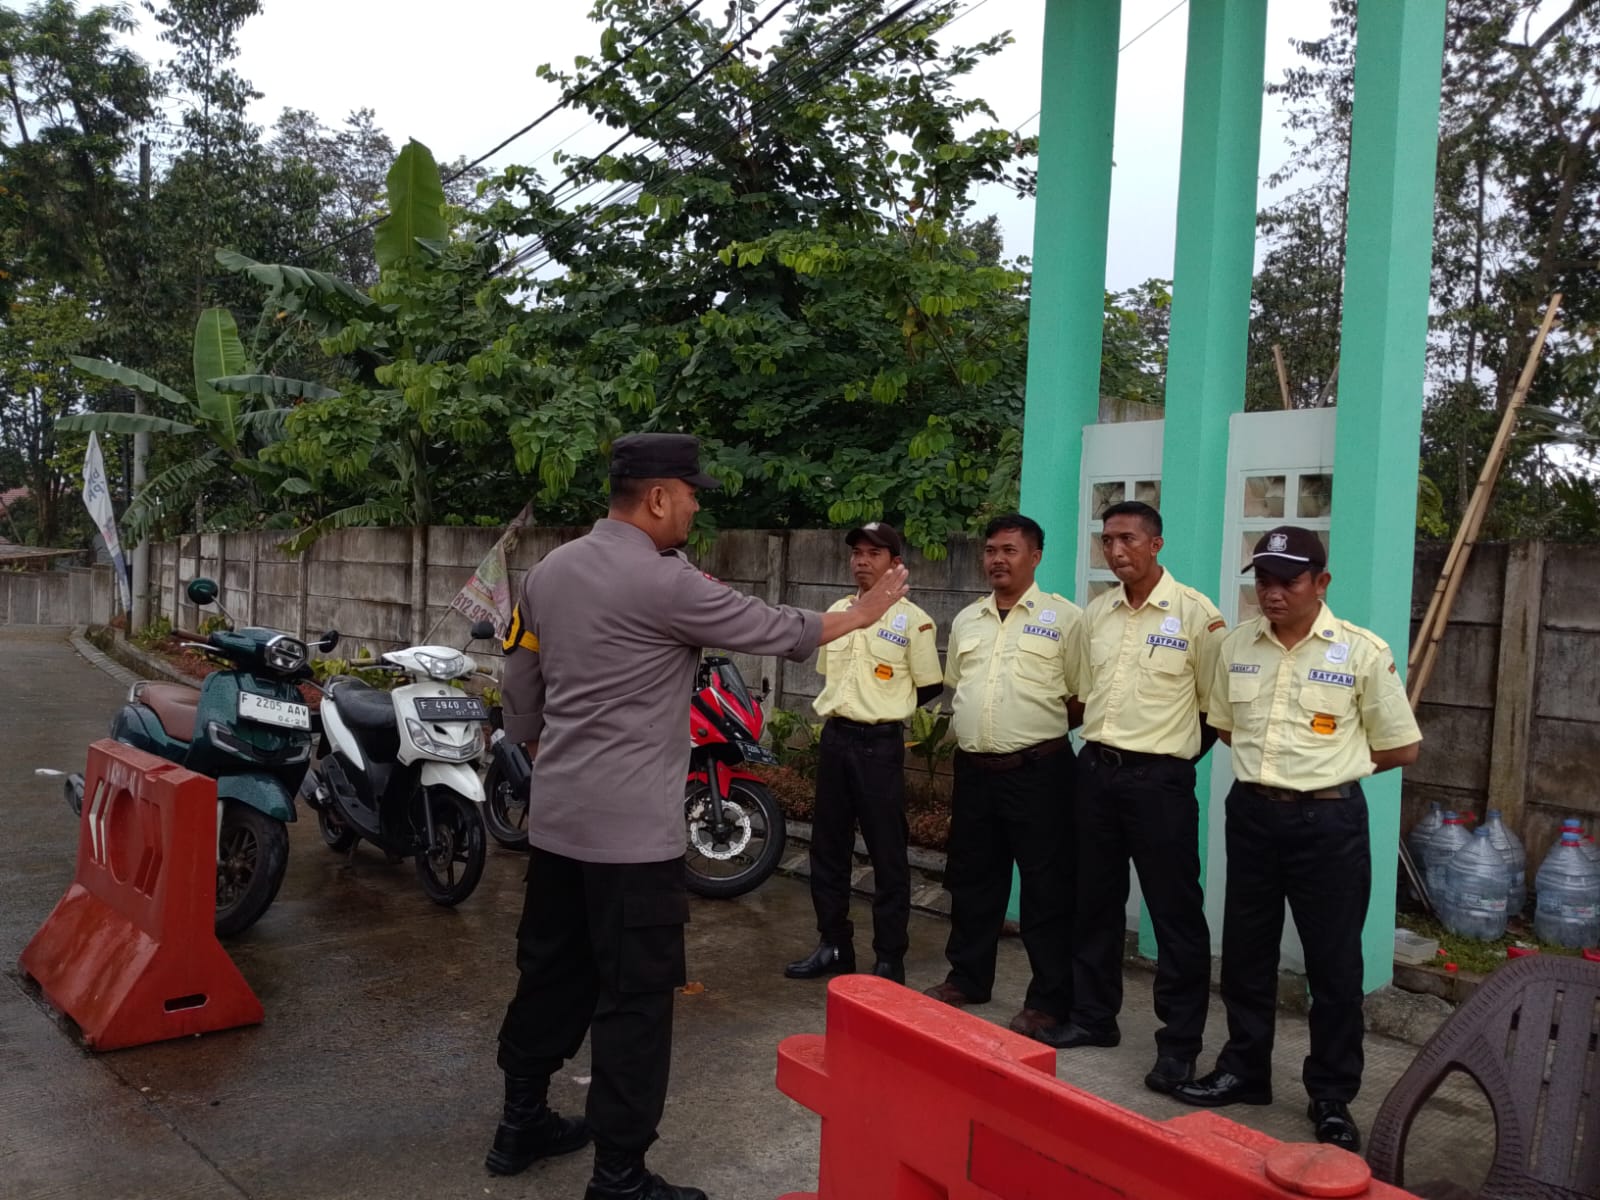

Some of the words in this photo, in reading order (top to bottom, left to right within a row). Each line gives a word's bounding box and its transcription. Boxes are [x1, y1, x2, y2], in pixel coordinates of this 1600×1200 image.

[879, 629, 907, 645] SATPAM
[1025, 626, 1058, 638] SATPAM
[1149, 635, 1186, 649] SATPAM
[1311, 670, 1353, 685] SATPAM
[241, 693, 248, 704] F
[256, 697, 282, 712] 2205
[287, 704, 307, 717] AAV
[420, 701, 427, 710] F
